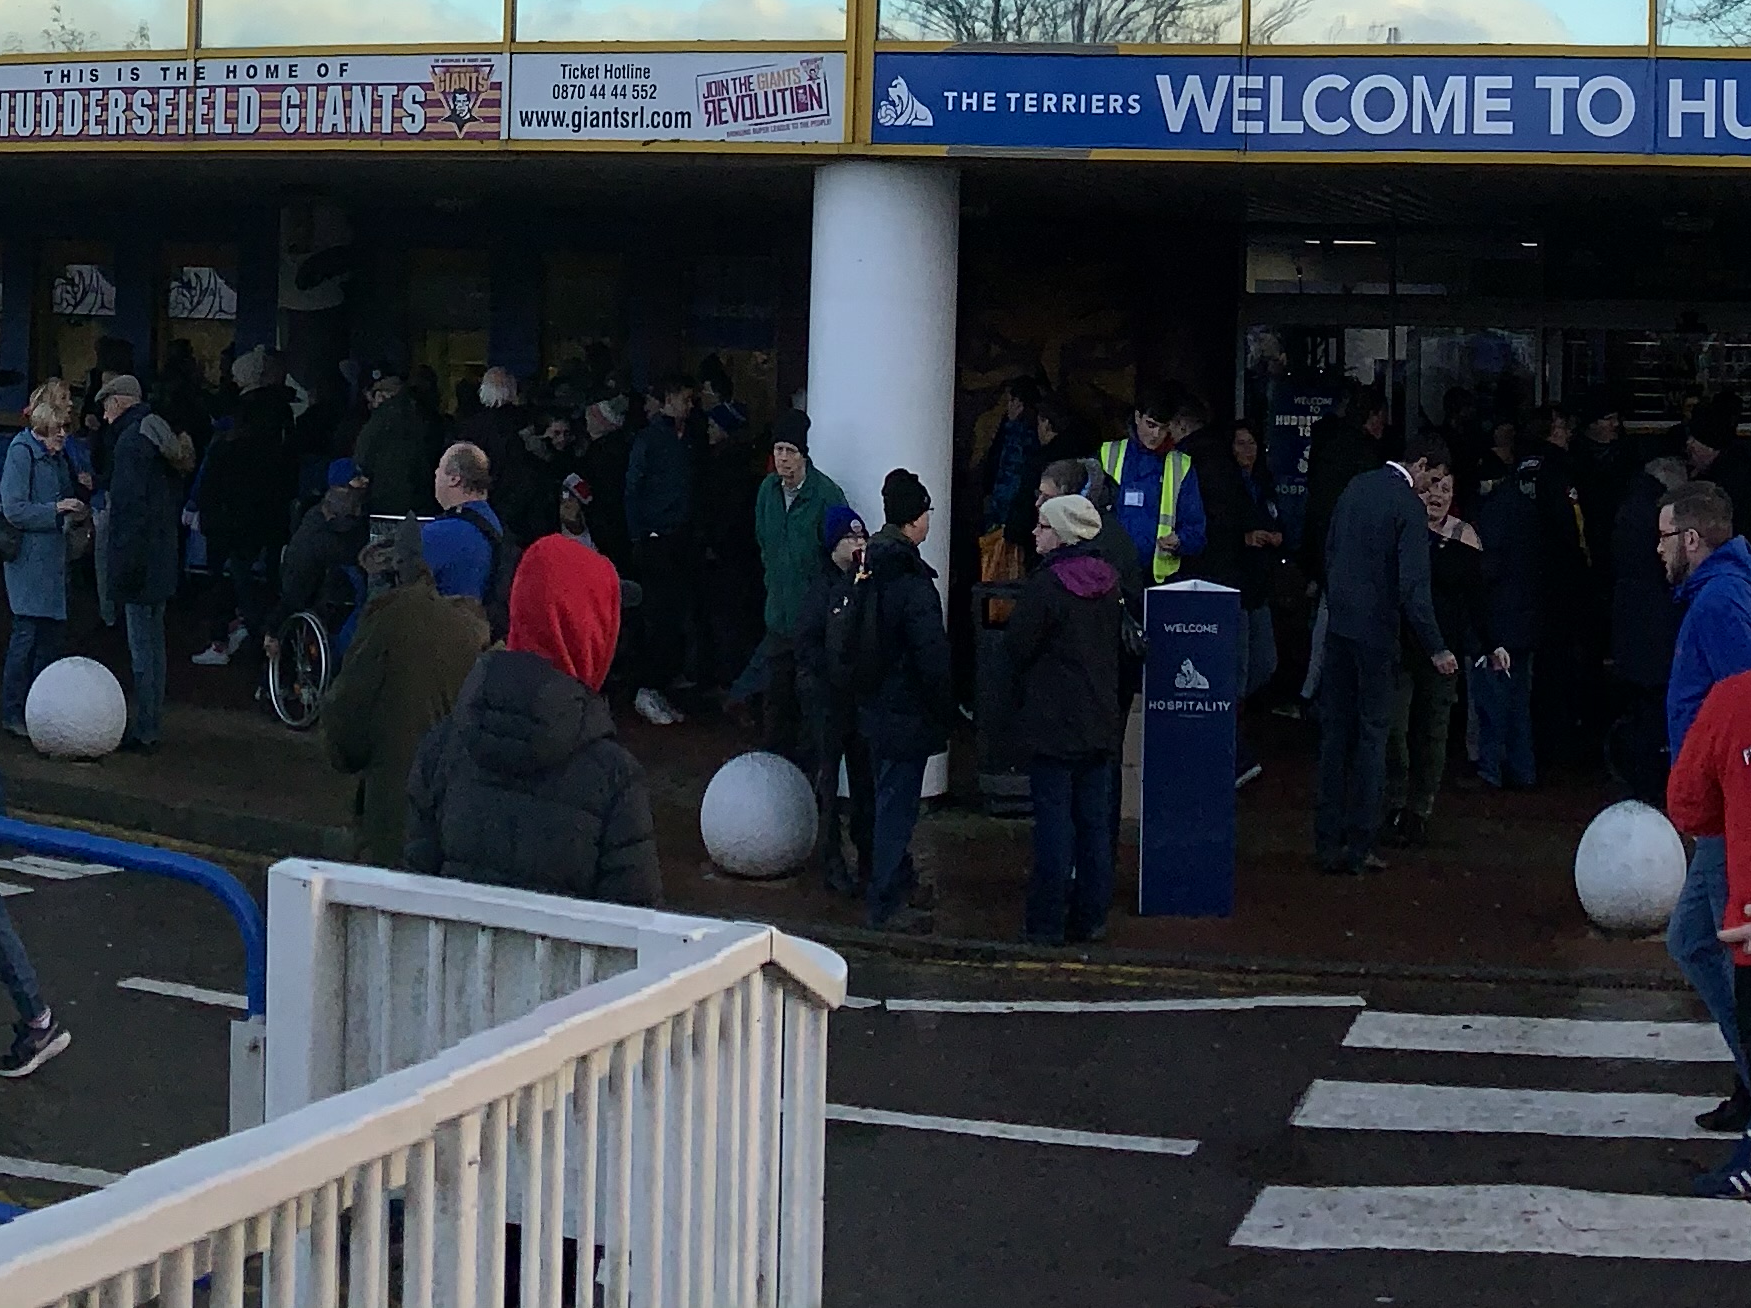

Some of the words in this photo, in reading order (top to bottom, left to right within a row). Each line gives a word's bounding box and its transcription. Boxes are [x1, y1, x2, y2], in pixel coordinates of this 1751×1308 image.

[43, 68, 100, 84] THIS
[117, 66, 141, 82] IS
[160, 66, 207, 81] THE
[226, 63, 299, 79] HOME
[317, 63, 350, 78] OF
[433, 71, 489, 92] GIANTS
[560, 63, 600, 80] Ticket
[604, 62, 651, 80] Hotline
[552, 84, 587, 100] 0870
[589, 84, 607, 100] 44
[610, 84, 628, 100] 44
[632, 84, 657, 99] 552
[702, 77, 730, 100] JOIN
[732, 74, 755, 94] THE
[756, 67, 802, 92] GIANTS
[279, 84, 428, 135] GIANTS
[943, 91, 997, 113] THE
[1006, 92, 1142, 115] TERRIERS
[1156, 73, 1513, 135] WELCOME
[1536, 75, 1636, 137] TO
[519, 106, 692, 133] www.giantsrl.com
[1163, 623, 1219, 634] WELCOME
[1148, 699, 1232, 712] HOSPITALITY
